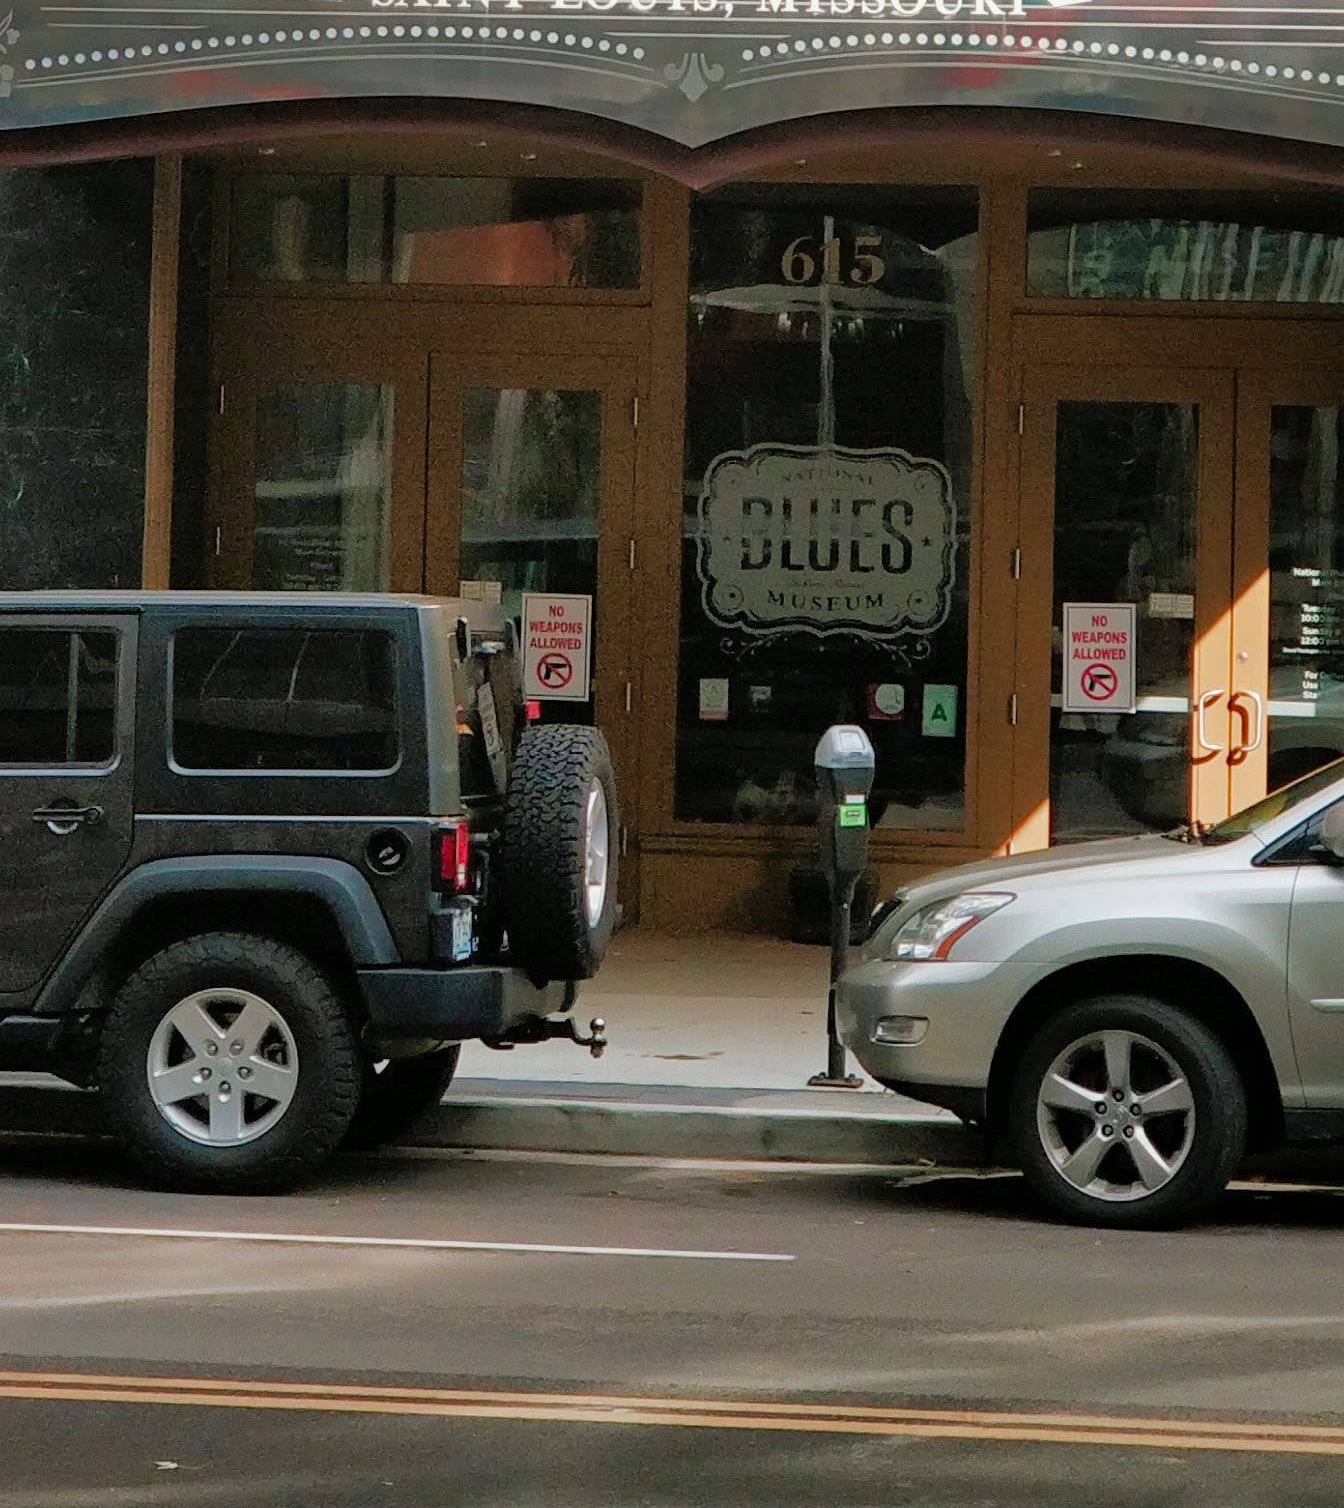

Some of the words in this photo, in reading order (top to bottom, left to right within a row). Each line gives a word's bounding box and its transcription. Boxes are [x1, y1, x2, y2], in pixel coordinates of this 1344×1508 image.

[781, 235, 886, 285] 615
[741, 497, 915, 575] BLUES
[767, 589, 884, 612] MUSEUM
[548, 604, 565, 618] NO
[529, 621, 583, 634] WEAPONS
[1091, 615, 1109, 627] NO
[529, 637, 582, 650] ALLOWED
[1071, 631, 1128, 644] WEAPONS
[1072, 648, 1127, 660] ALLOWED
